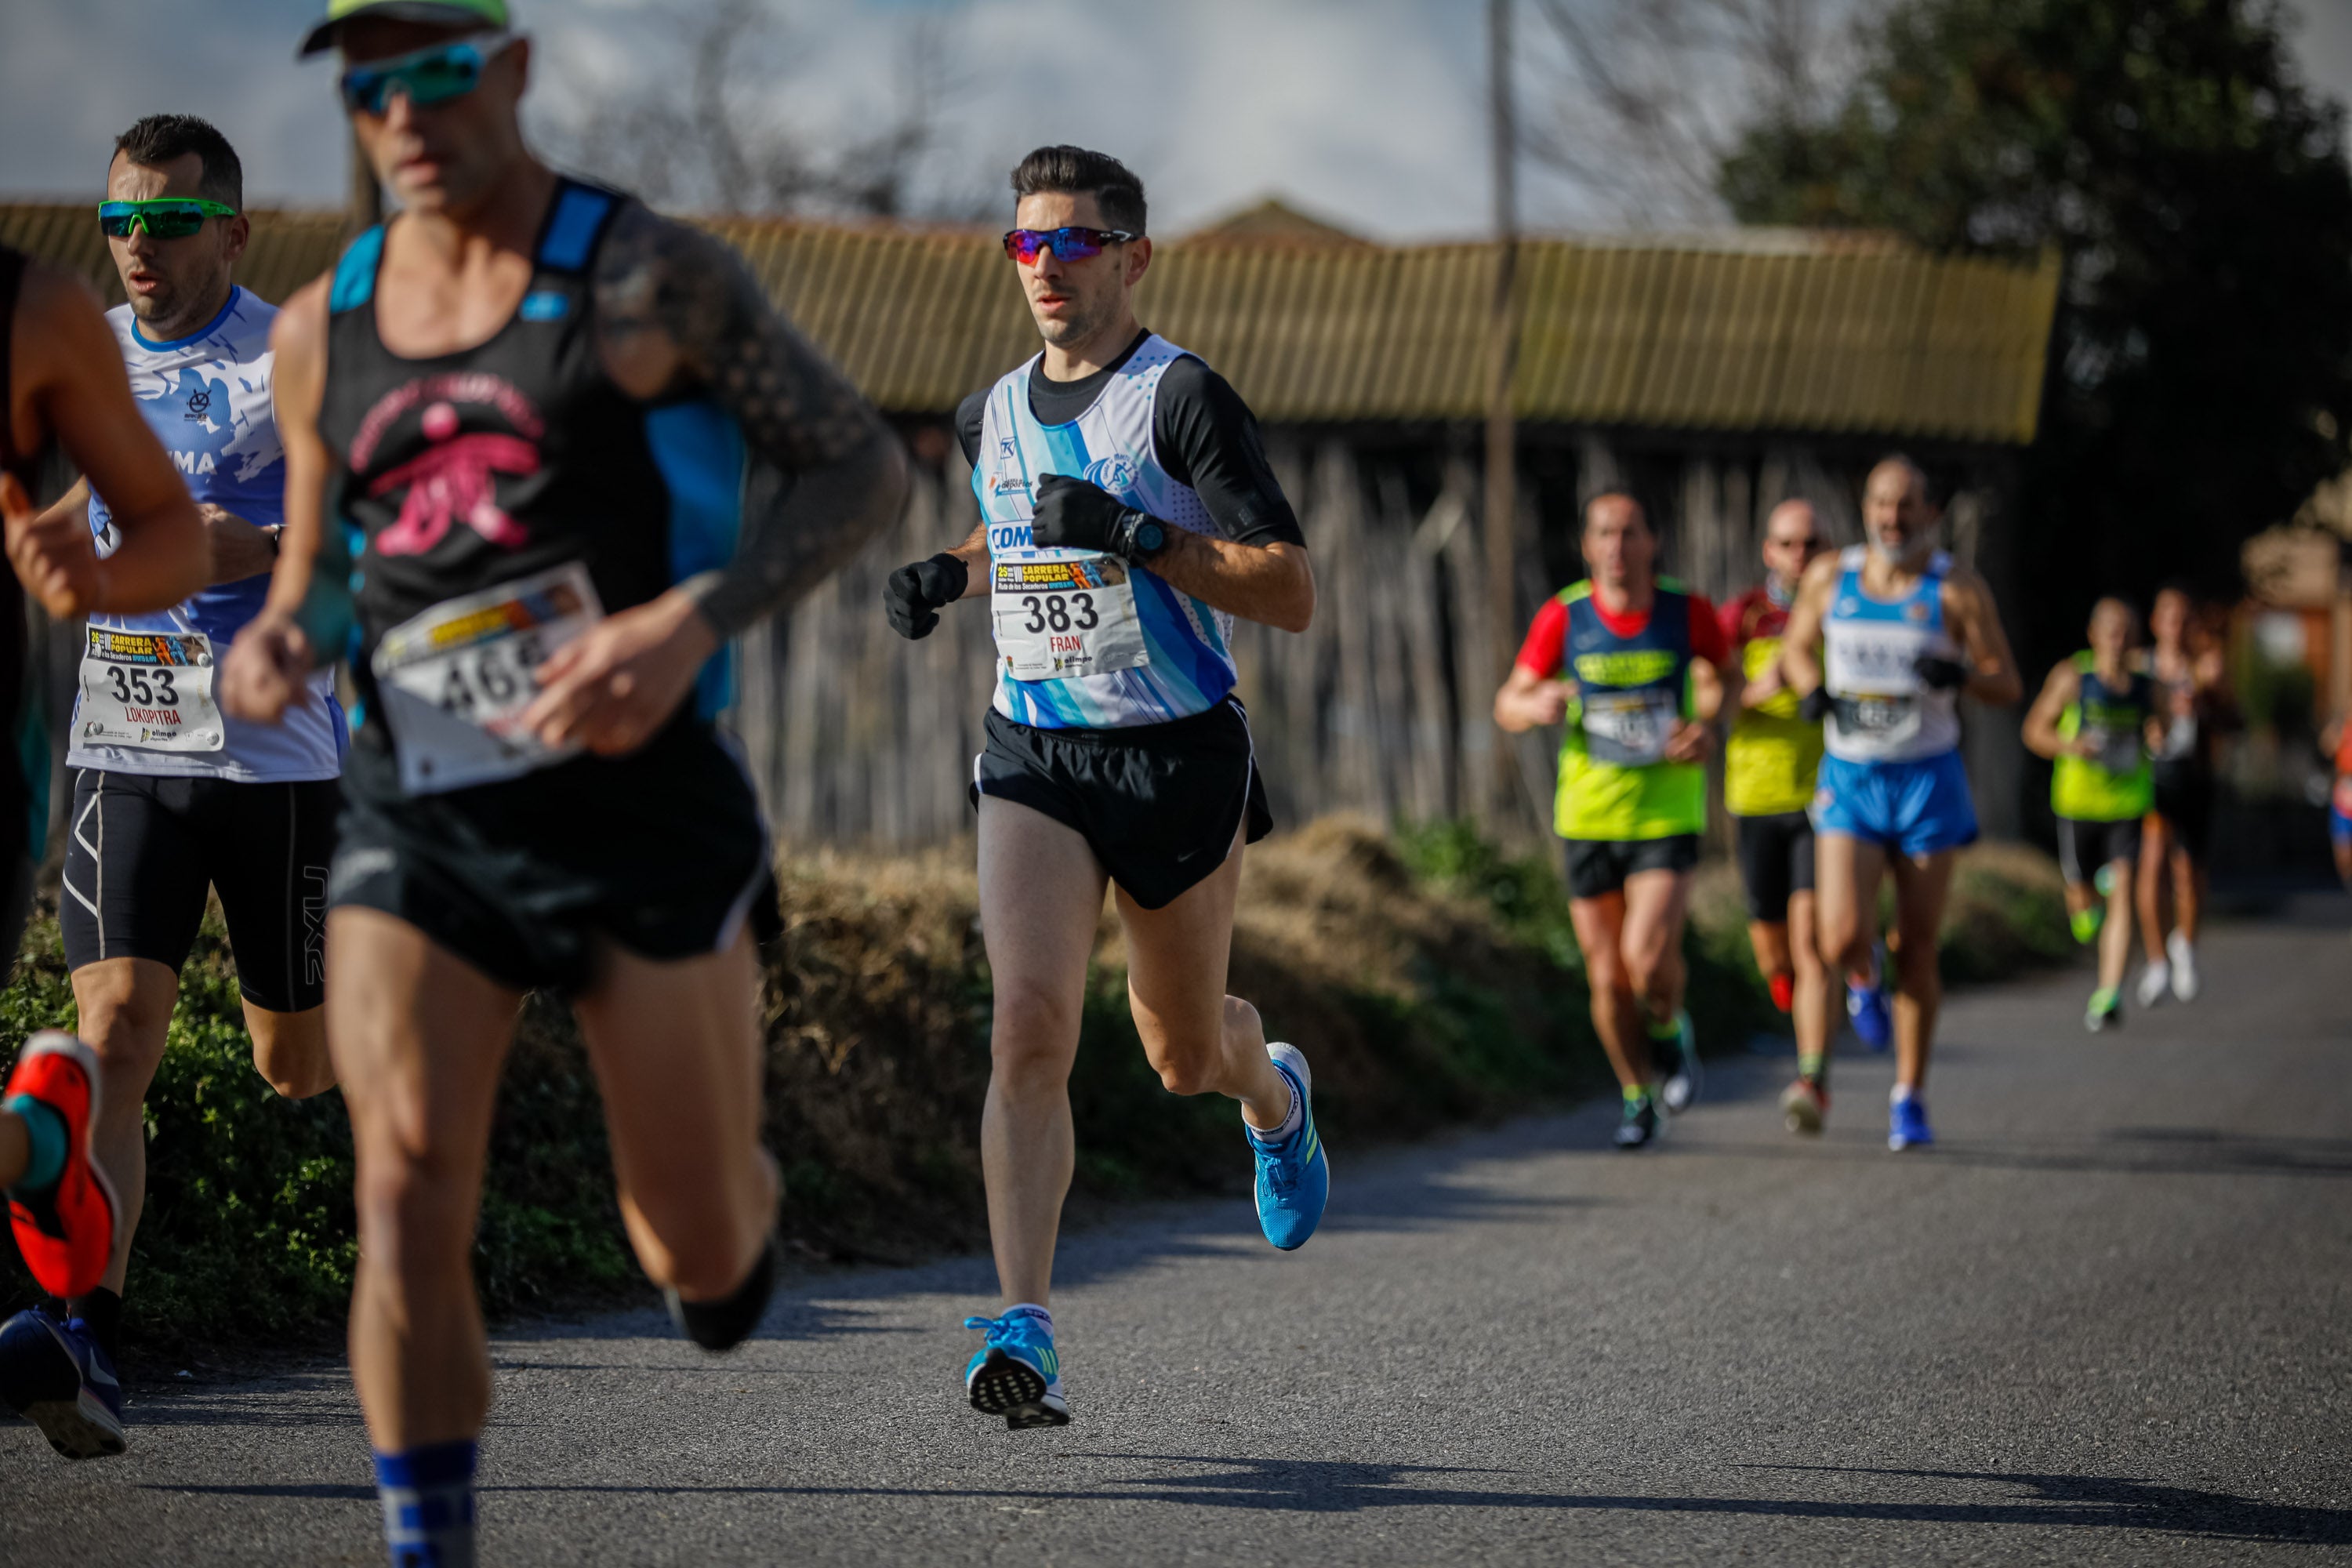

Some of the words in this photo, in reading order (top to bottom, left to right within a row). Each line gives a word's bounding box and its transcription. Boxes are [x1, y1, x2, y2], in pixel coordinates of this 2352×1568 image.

[167, 450, 217, 475] MA
[1022, 564, 1068, 575] CARRERA
[1024, 573, 1069, 583] POPULAR
[1022, 593, 1098, 633] 383
[92, 631, 99, 643] 26
[111, 633, 151, 647] CARRERA
[111, 644, 152, 654] POPULAR
[1051, 636, 1081, 652] FRAN
[111, 652, 132, 661] Secaderos
[1065, 656, 1092, 665] olimpo
[107, 666, 179, 706] 353
[125, 706, 182, 726] LOKOPITRA
[152, 728, 176, 738] olimpo
